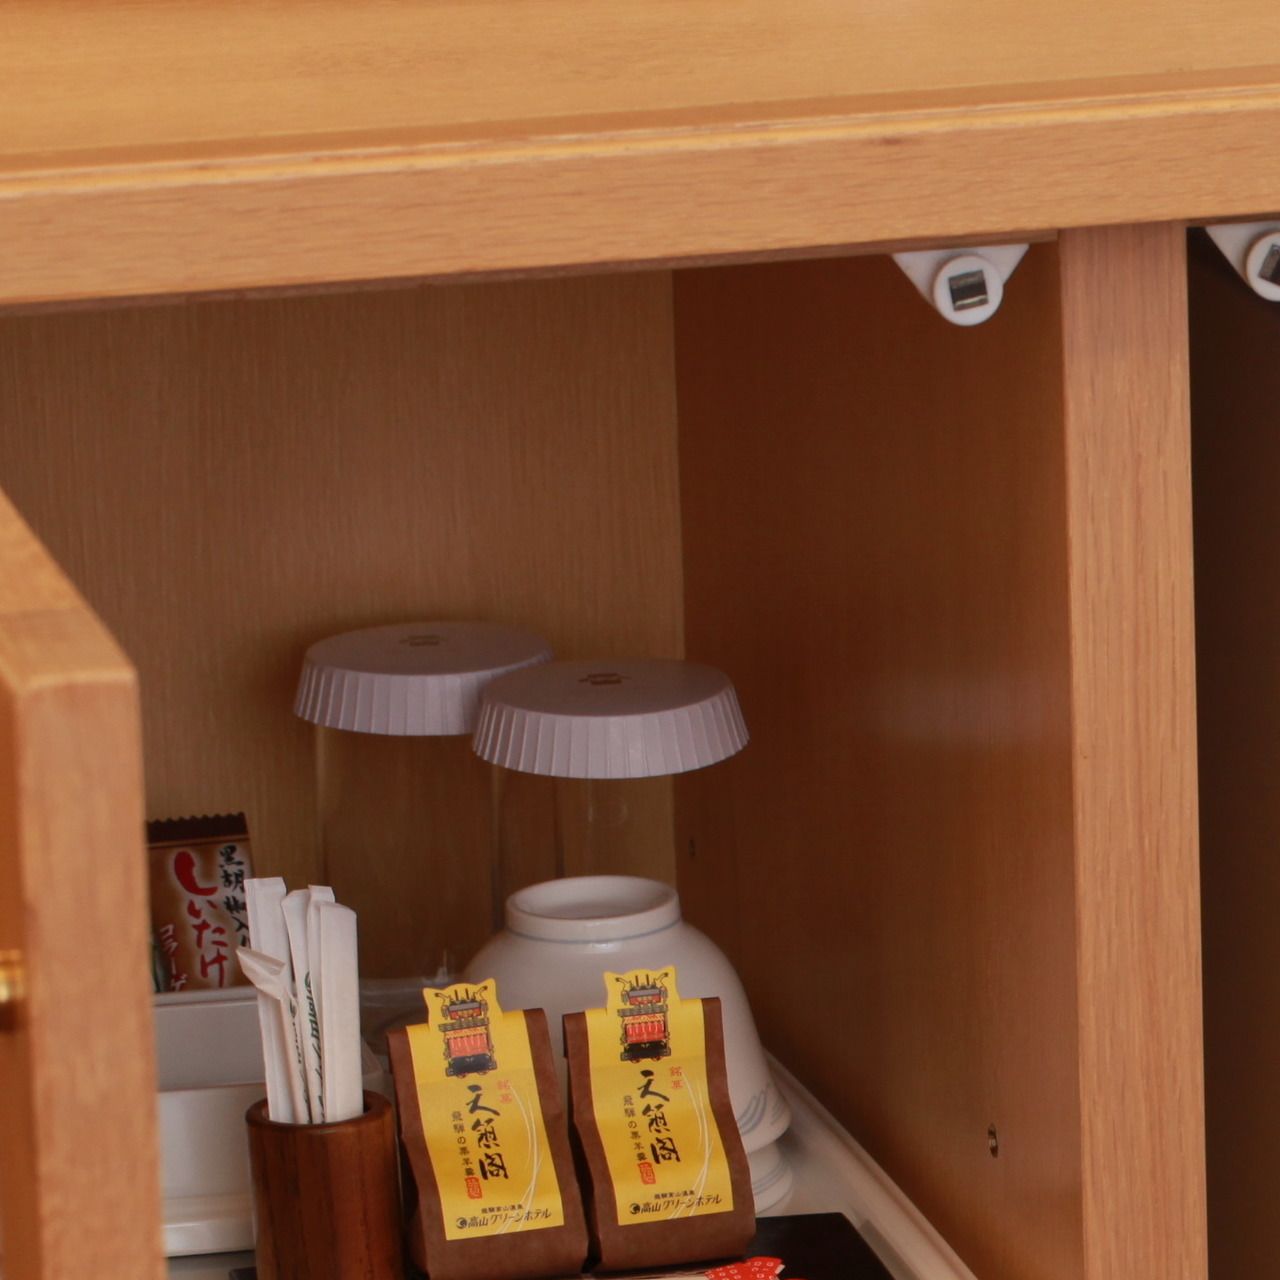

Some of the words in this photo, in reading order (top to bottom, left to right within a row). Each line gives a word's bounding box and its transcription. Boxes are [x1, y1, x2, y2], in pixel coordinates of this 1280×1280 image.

[174, 850, 229, 988] しいたけ
[641, 1194, 722, 1213] 高山グリーンホテル
[468, 1208, 551, 1228] 高山グリーンホテル
